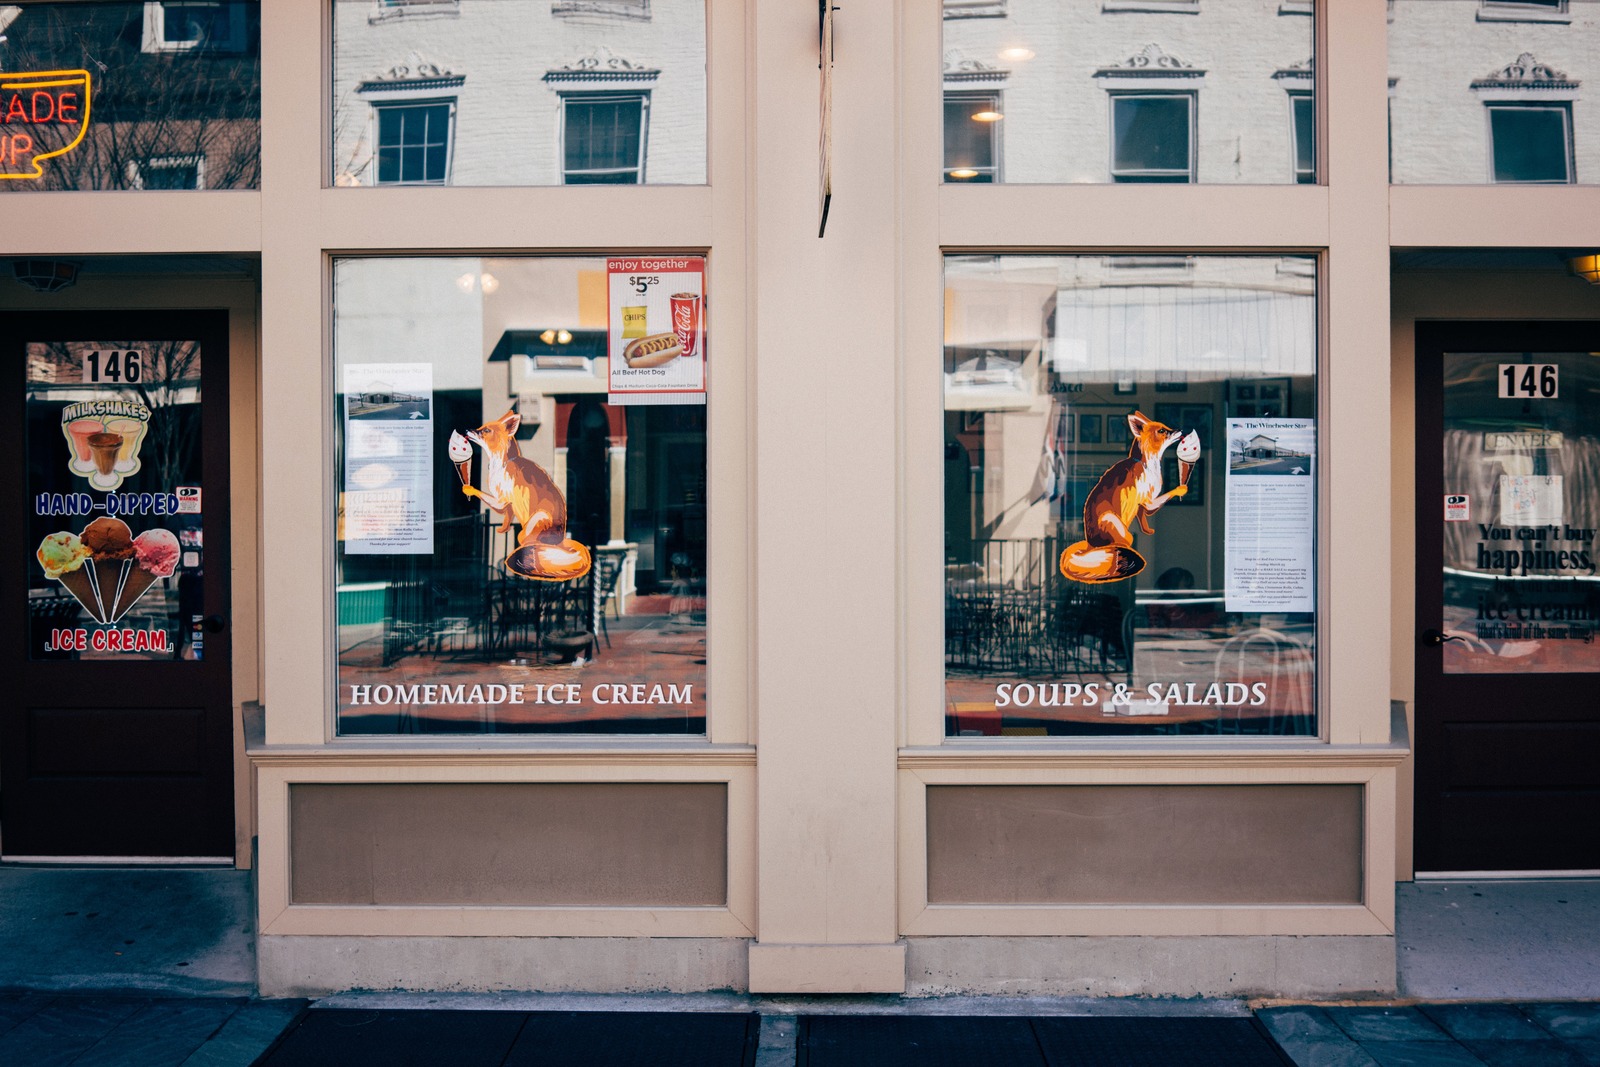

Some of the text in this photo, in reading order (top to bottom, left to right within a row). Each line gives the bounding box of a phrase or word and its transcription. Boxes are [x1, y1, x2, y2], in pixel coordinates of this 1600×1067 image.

[0, 92, 78, 124] ADE
[608, 259, 689, 271] enjoy together
[624, 313, 647, 322] CHIPS
[88, 351, 140, 383] 146
[651, 369, 666, 377] Dog
[1504, 365, 1556, 397] 146
[63, 400, 149, 424] MILKSHAKES
[1495, 433, 1553, 448] ENTER
[36, 492, 181, 517] HAND-DIPPED
[1478, 523, 1598, 545] You can't buy
[1477, 542, 1596, 576] happiness,
[1477, 594, 1509, 620] ice
[52, 628, 167, 652] ICE CREAM
[350, 684, 693, 705] HOMEMADE ICE CREAM
[995, 683, 1267, 707] SOUPS & SALADS
